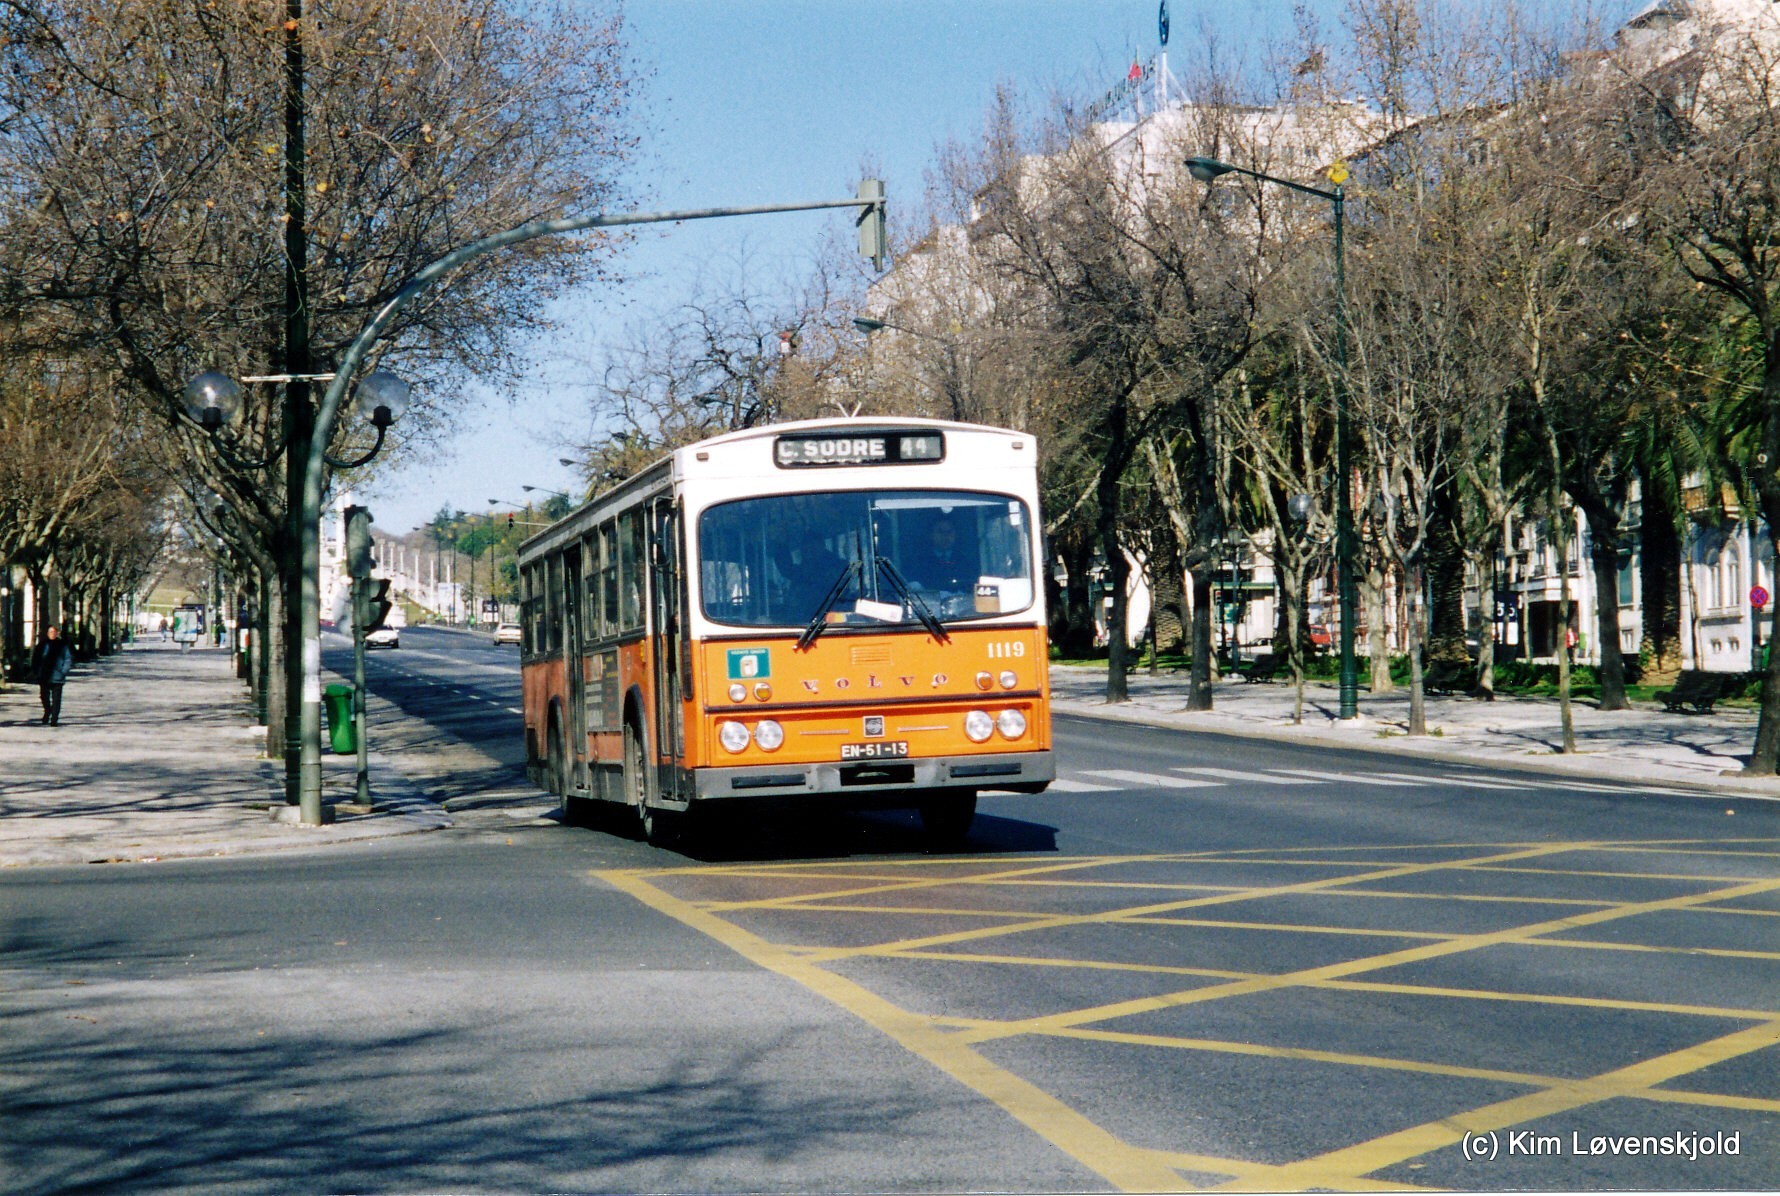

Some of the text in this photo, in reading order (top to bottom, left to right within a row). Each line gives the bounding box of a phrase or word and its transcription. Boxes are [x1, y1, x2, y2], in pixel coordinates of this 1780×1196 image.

[804, 438, 886, 457] SODRE
[901, 438, 928, 457] 44
[987, 641, 1025, 658] 1119
[801, 672, 948, 692] VOLVO
[841, 742, 908, 758] EN-51-13
